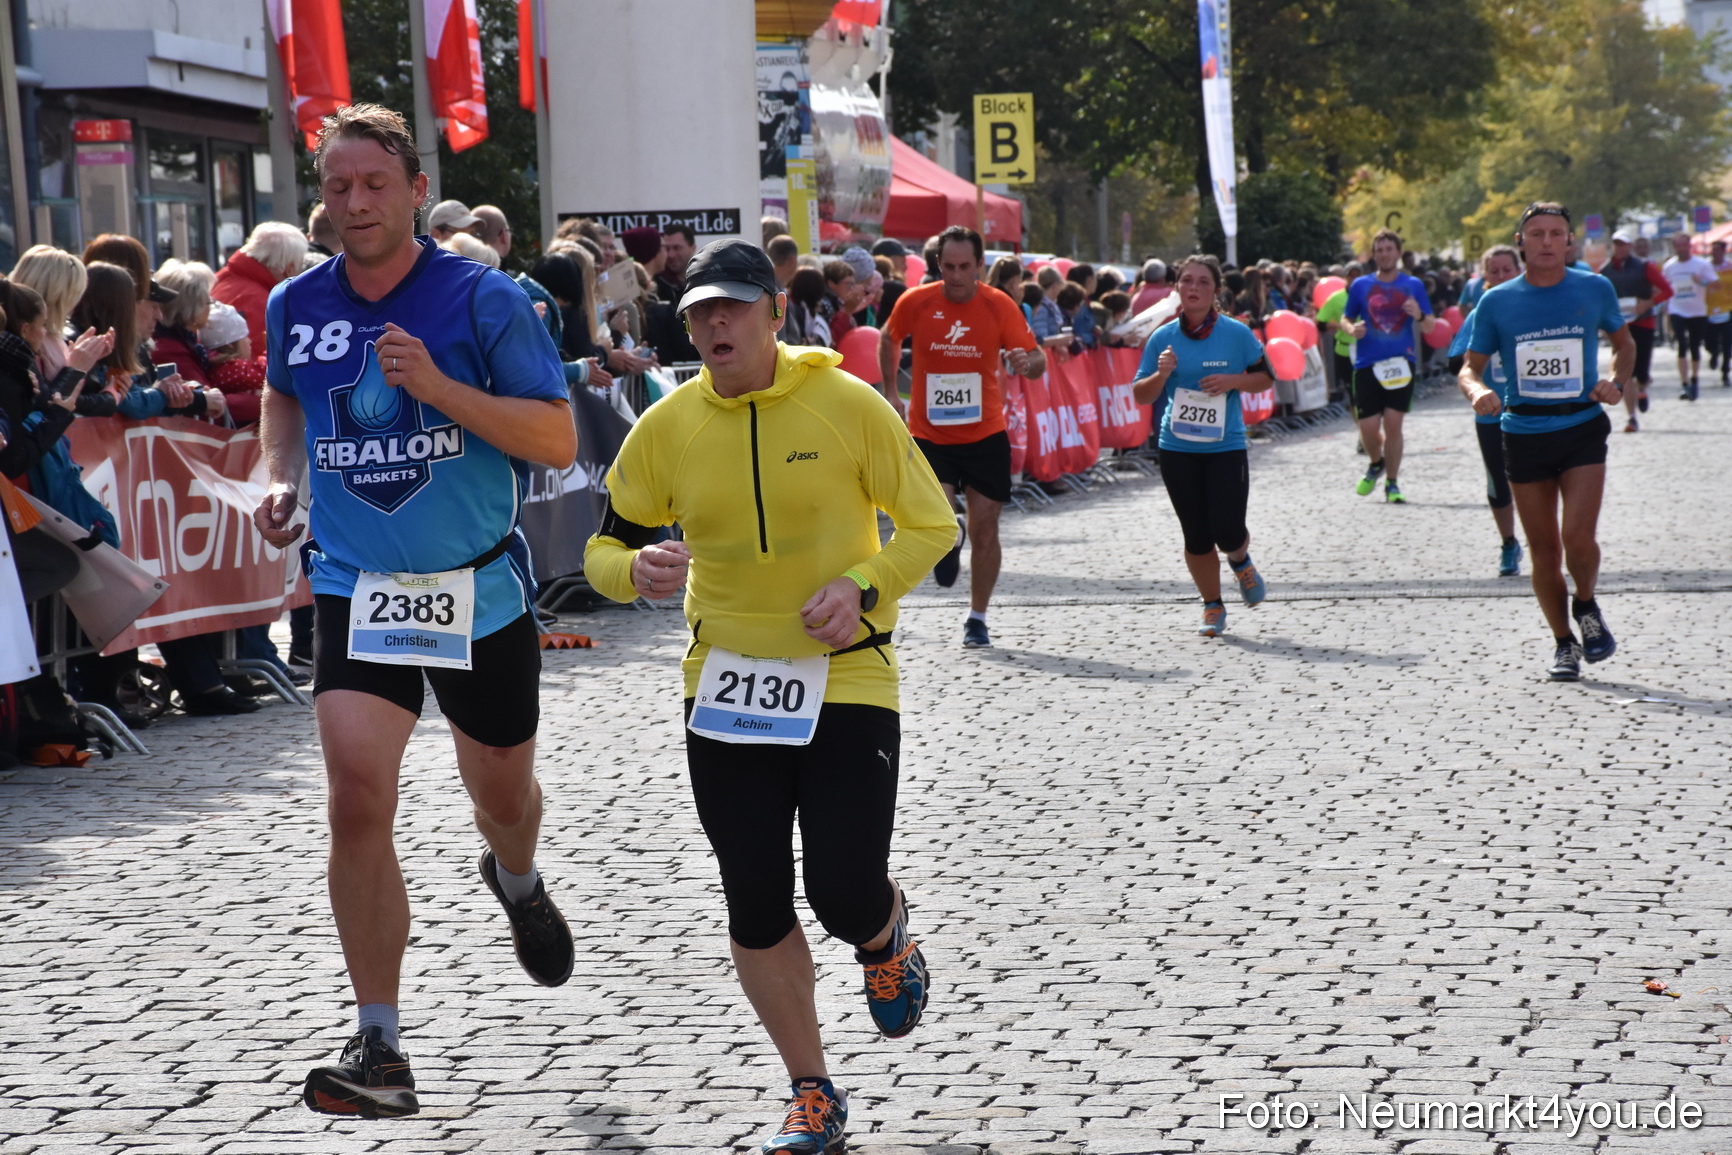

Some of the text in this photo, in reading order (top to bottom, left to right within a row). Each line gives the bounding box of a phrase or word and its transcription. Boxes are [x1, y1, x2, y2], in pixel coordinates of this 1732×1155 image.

[981, 97, 1026, 115] Block
[990, 122, 1019, 164] B
[1515, 325, 1584, 342] www.hasit.de
[288, 320, 353, 366] 28
[930, 342, 976, 352] funrunners
[943, 350, 982, 358] neumarkt
[1526, 357, 1570, 376] 2381
[934, 389, 971, 405] 2641
[1179, 405, 1217, 424] 2378
[316, 428, 461, 470] FIBALON
[797, 451, 818, 461] asics
[353, 469, 417, 485] BASKETS
[368, 591, 455, 626] 2383
[384, 634, 438, 649] Christian
[714, 670, 806, 713] 2130
[733, 717, 773, 730] Achim
